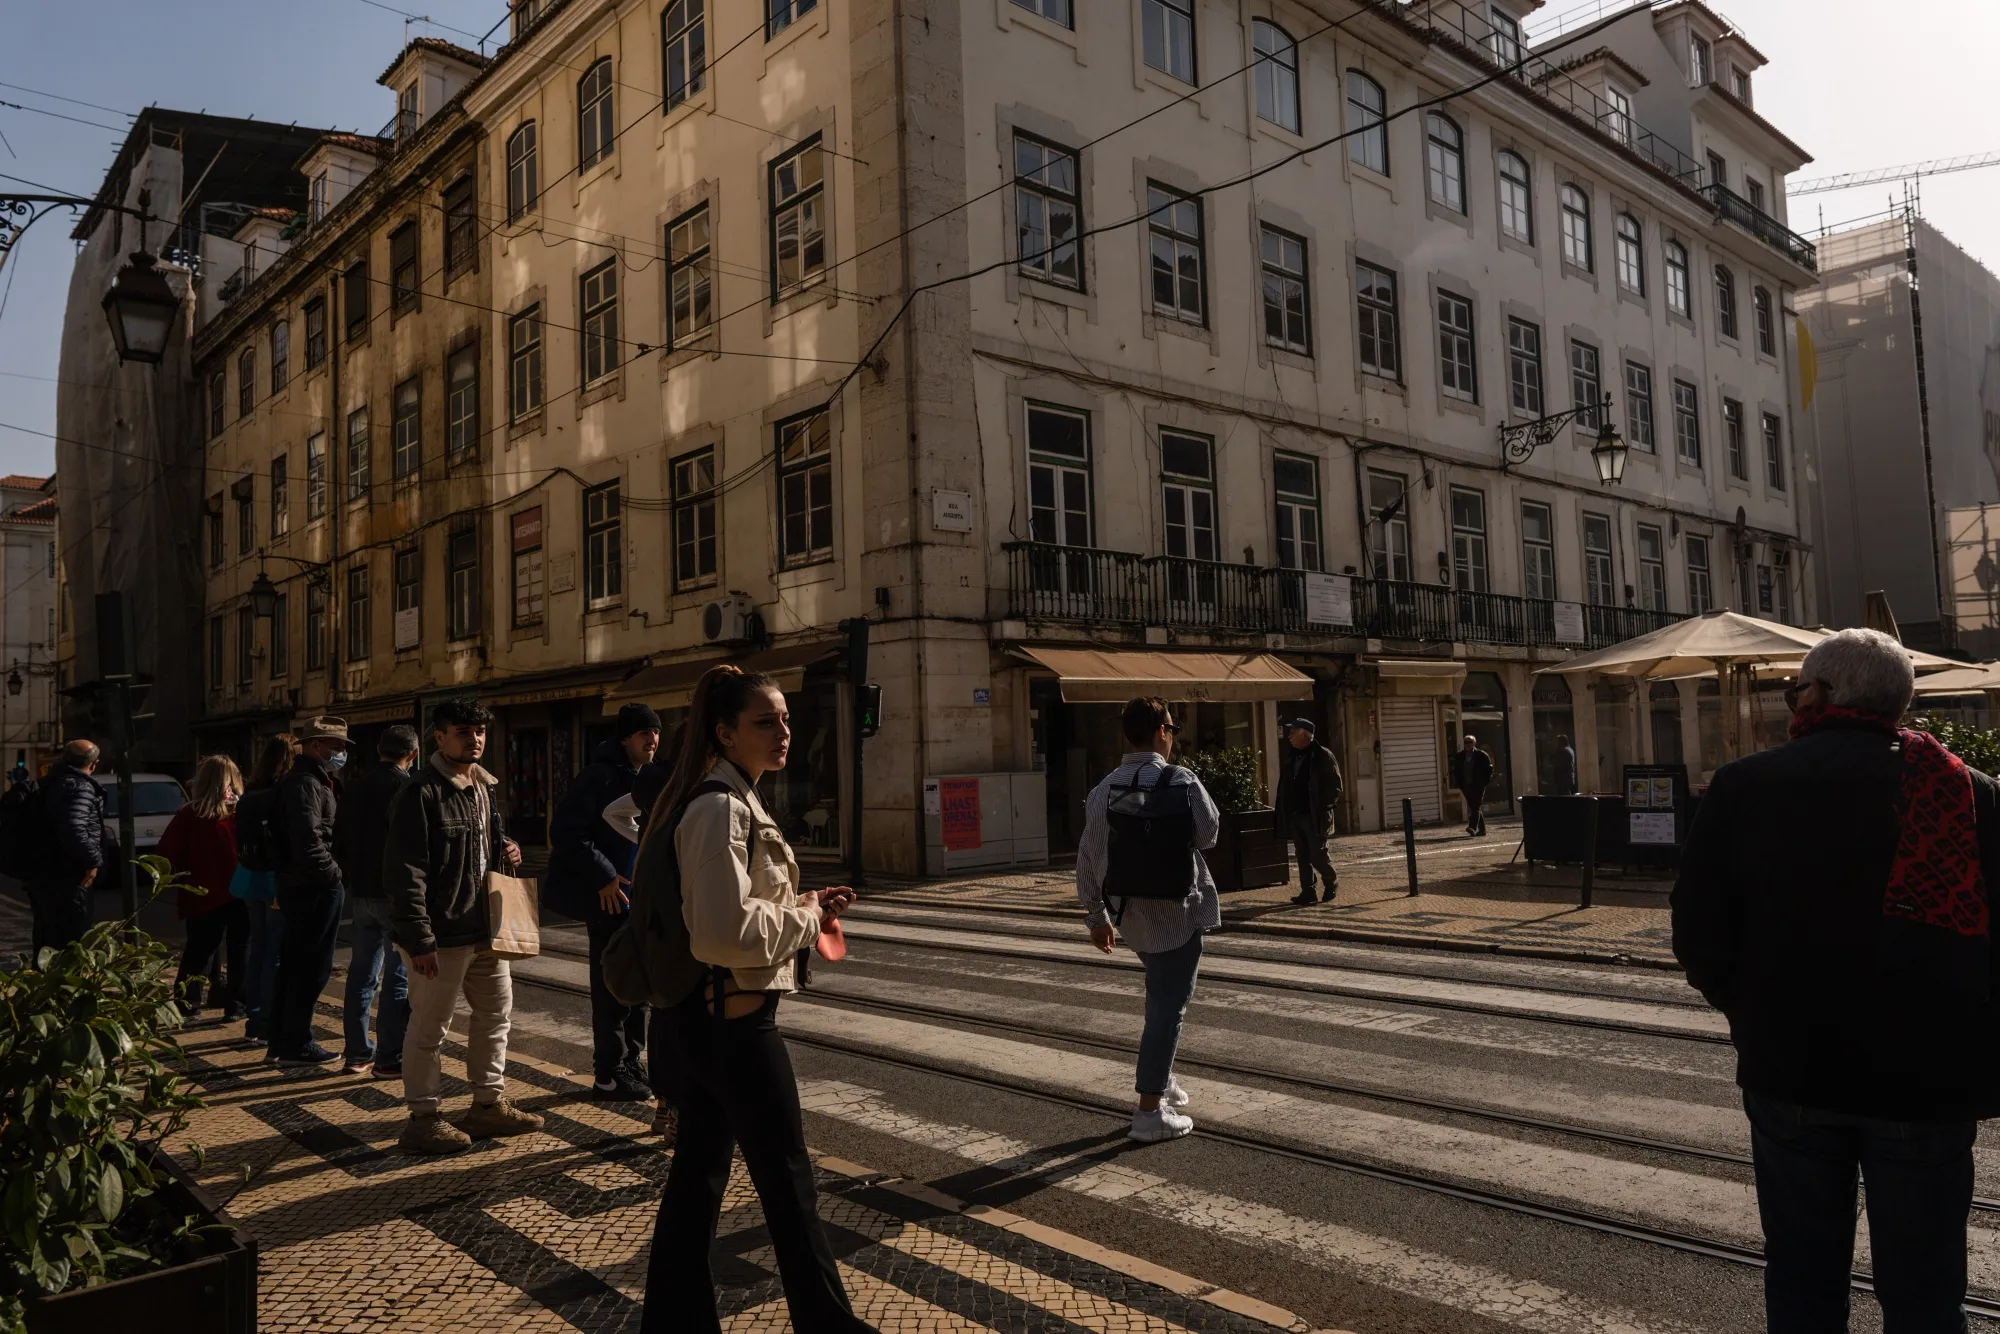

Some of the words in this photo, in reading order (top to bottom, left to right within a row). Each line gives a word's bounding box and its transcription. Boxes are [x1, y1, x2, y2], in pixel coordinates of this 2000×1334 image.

[942, 512, 964, 520] AUGUSTA
[515, 520, 541, 539] ARTESANATO
[943, 797, 977, 811] LHAST
[944, 811, 977, 822] DRENAZ
